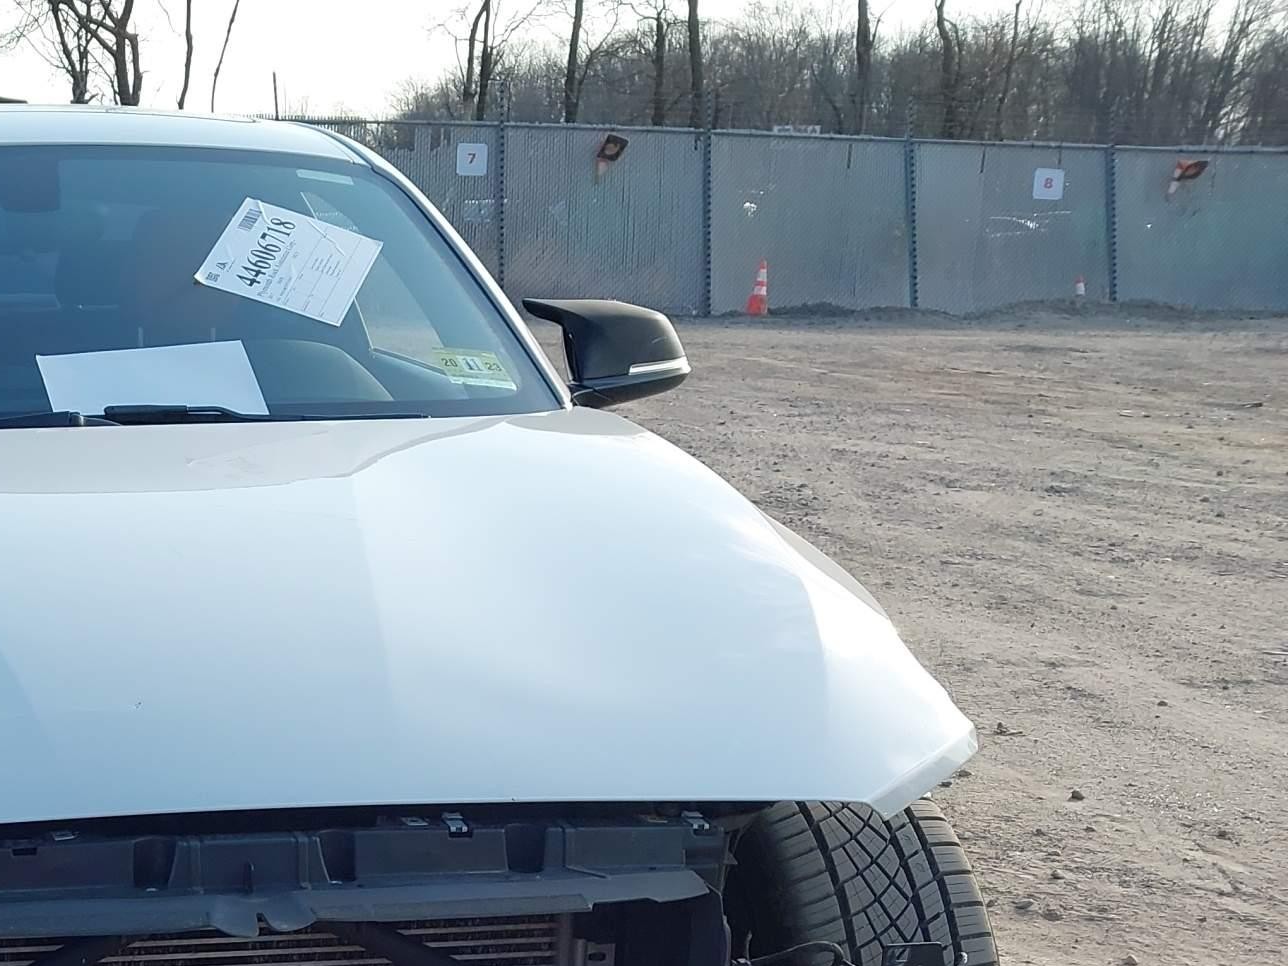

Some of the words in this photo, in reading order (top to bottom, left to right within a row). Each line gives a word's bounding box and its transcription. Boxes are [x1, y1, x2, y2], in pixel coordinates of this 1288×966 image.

[467, 152, 476, 164] 7
[1043, 177, 1054, 189] 8
[236, 217, 296, 287] 44606718
[441, 358, 458, 368] 20
